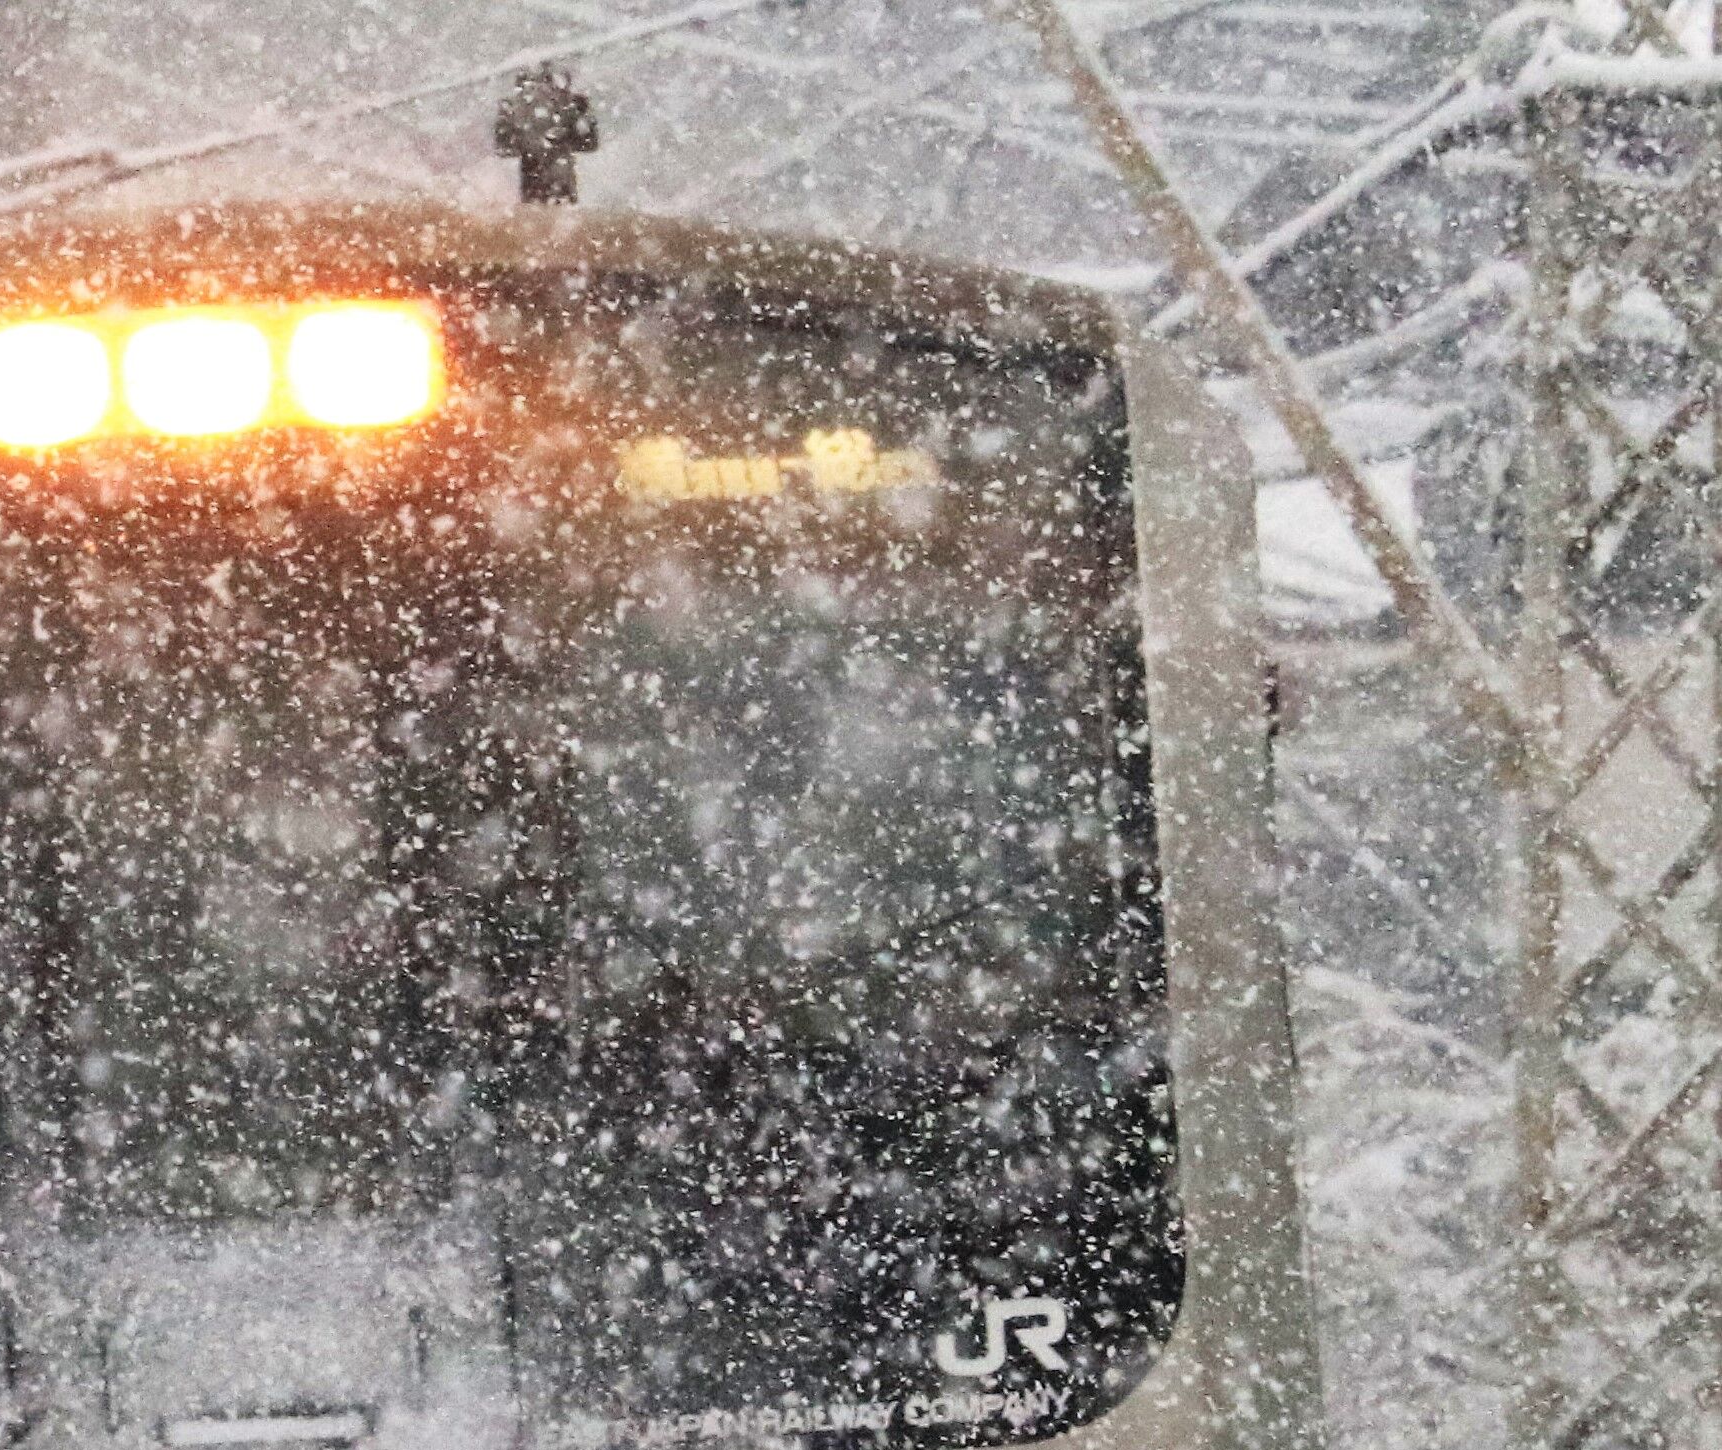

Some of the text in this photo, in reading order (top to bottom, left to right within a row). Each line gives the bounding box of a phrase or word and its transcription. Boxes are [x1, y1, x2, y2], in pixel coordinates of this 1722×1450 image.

[937, 1298, 1069, 1377] JR
[758, 1402, 900, 1435] RAILWAY
[905, 1384, 1072, 1428] COMPANY
